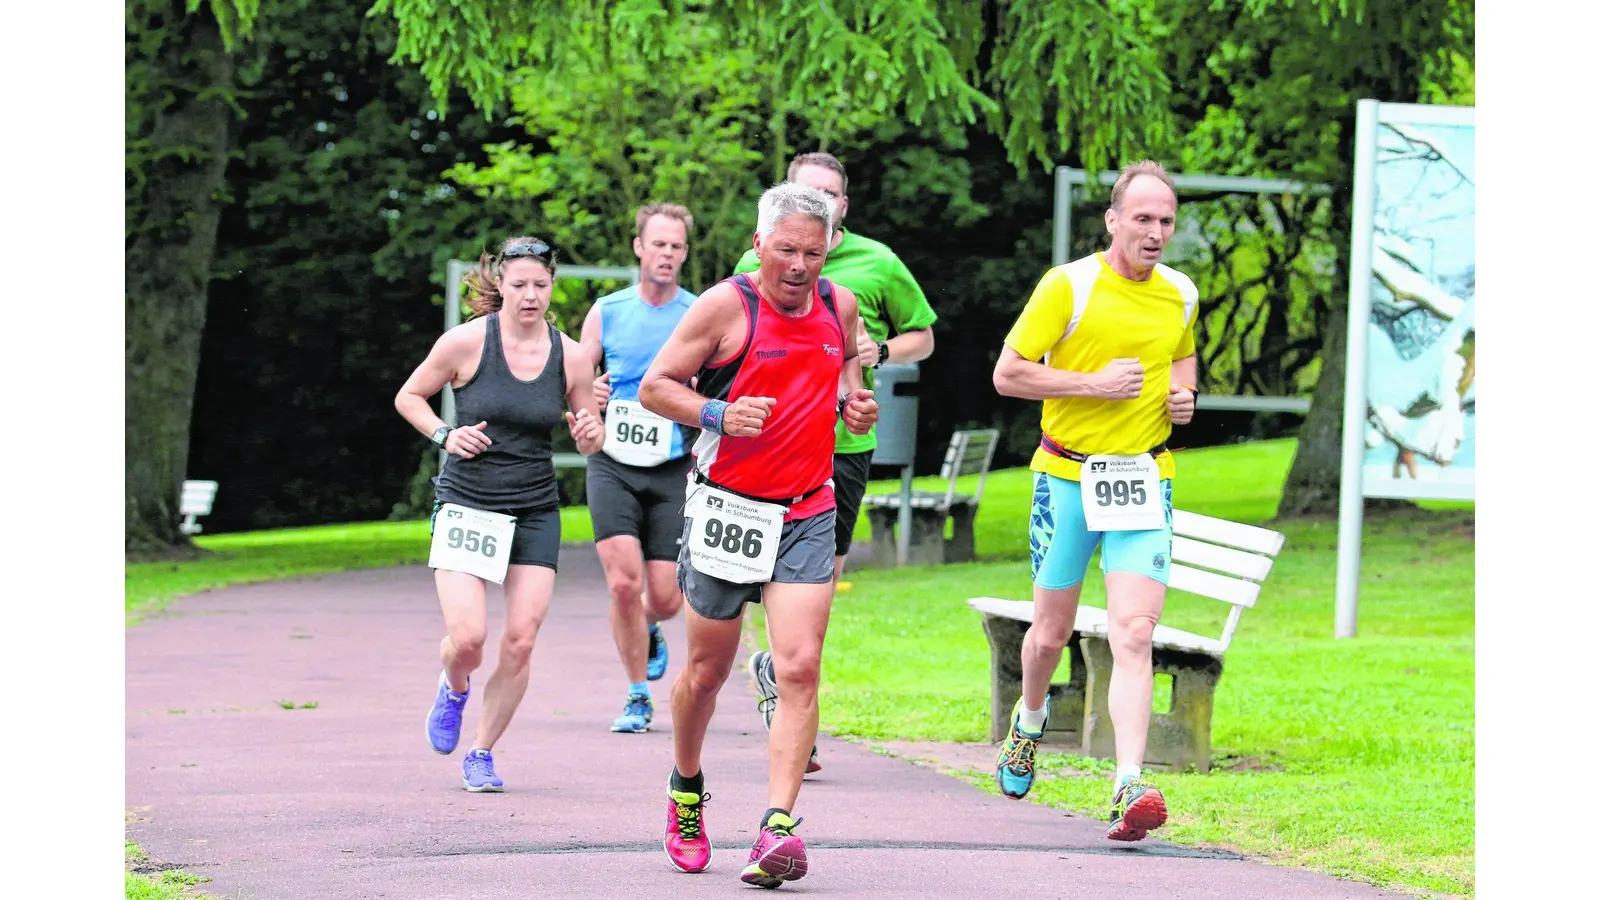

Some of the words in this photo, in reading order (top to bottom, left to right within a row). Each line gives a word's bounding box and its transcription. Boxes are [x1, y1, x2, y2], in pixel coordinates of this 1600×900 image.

[756, 349, 787, 360] Thomas
[616, 421, 659, 447] 964
[1095, 480, 1147, 507] 995
[727, 501, 758, 514] Volksbank
[733, 510, 772, 525] Schaumburg
[447, 527, 498, 558] 956
[704, 518, 764, 559] 986
